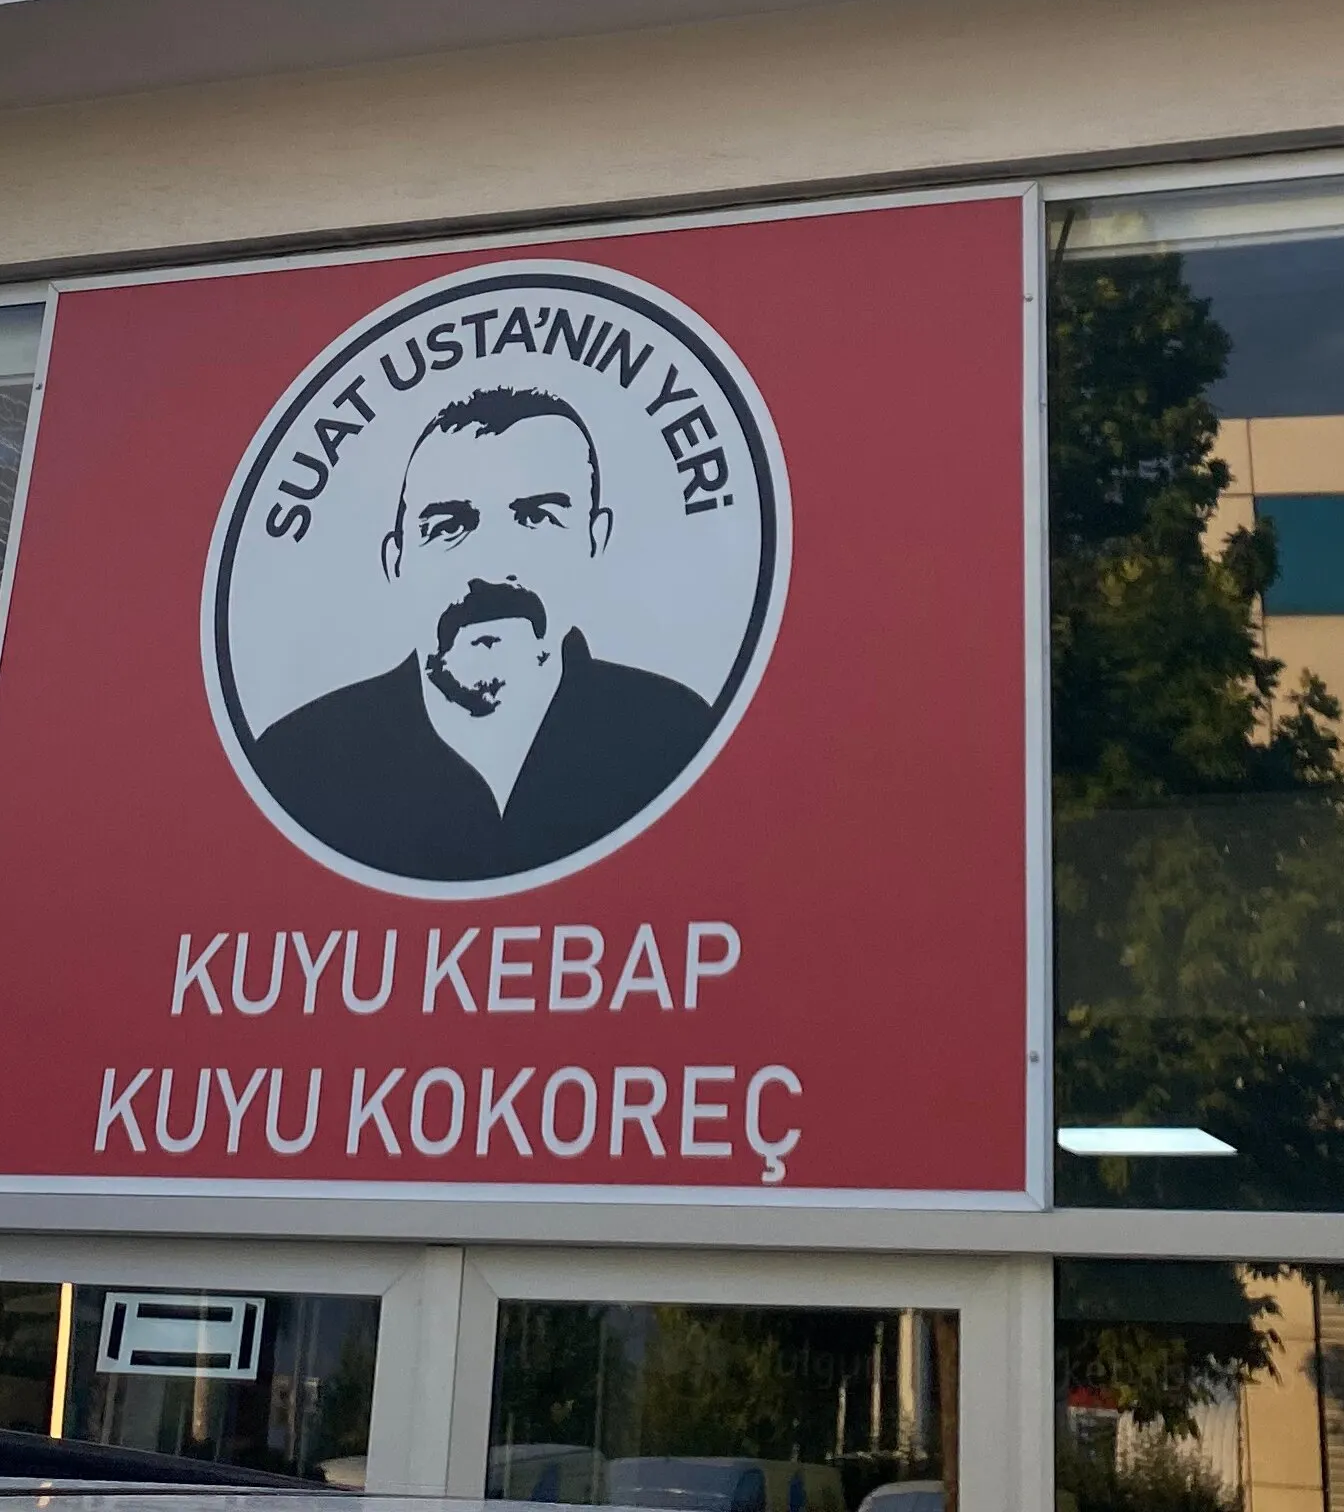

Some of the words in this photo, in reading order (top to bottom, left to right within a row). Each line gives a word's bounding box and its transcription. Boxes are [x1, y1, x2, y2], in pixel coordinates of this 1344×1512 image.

[265, 374, 377, 544] SUAT
[170, 929, 398, 1016] KUYU
[422, 921, 742, 1014] KEBAP
[93, 1067, 323, 1155] KUYU
[346, 1064, 804, 1183] KOKOREÇ
